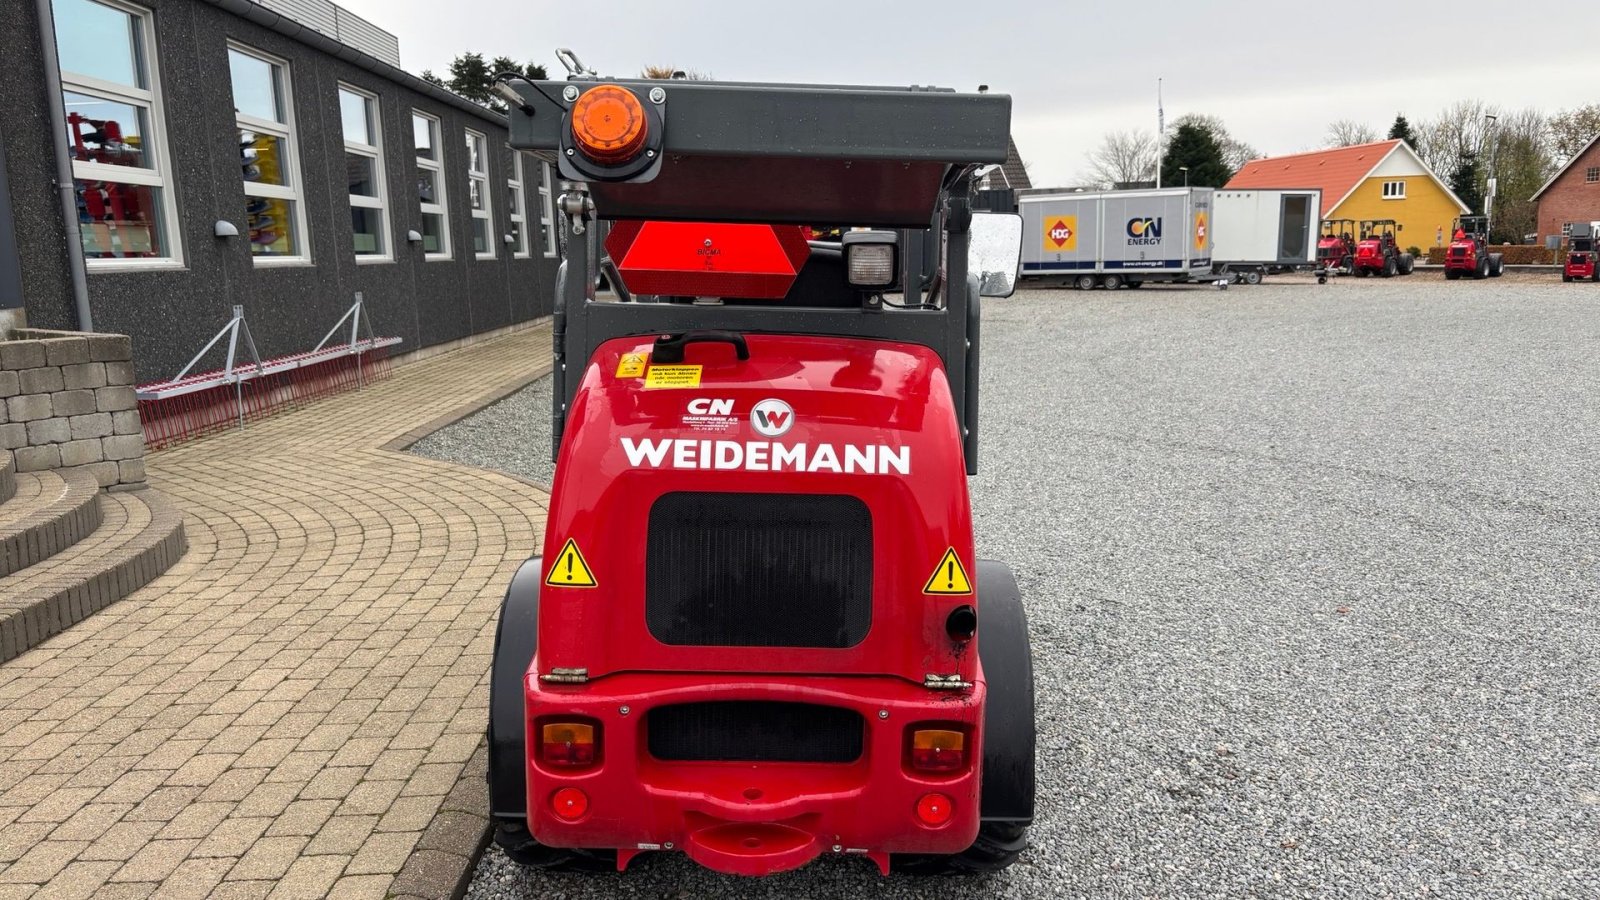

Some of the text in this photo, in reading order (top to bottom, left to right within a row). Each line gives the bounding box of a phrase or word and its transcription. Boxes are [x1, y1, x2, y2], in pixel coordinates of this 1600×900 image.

[1051, 228, 1069, 239] HDG
[1126, 217, 1163, 238] CN
[1127, 238, 1161, 246] ENERGY
[687, 398, 735, 415] CN
[620, 437, 910, 475] WEIDEMANN
